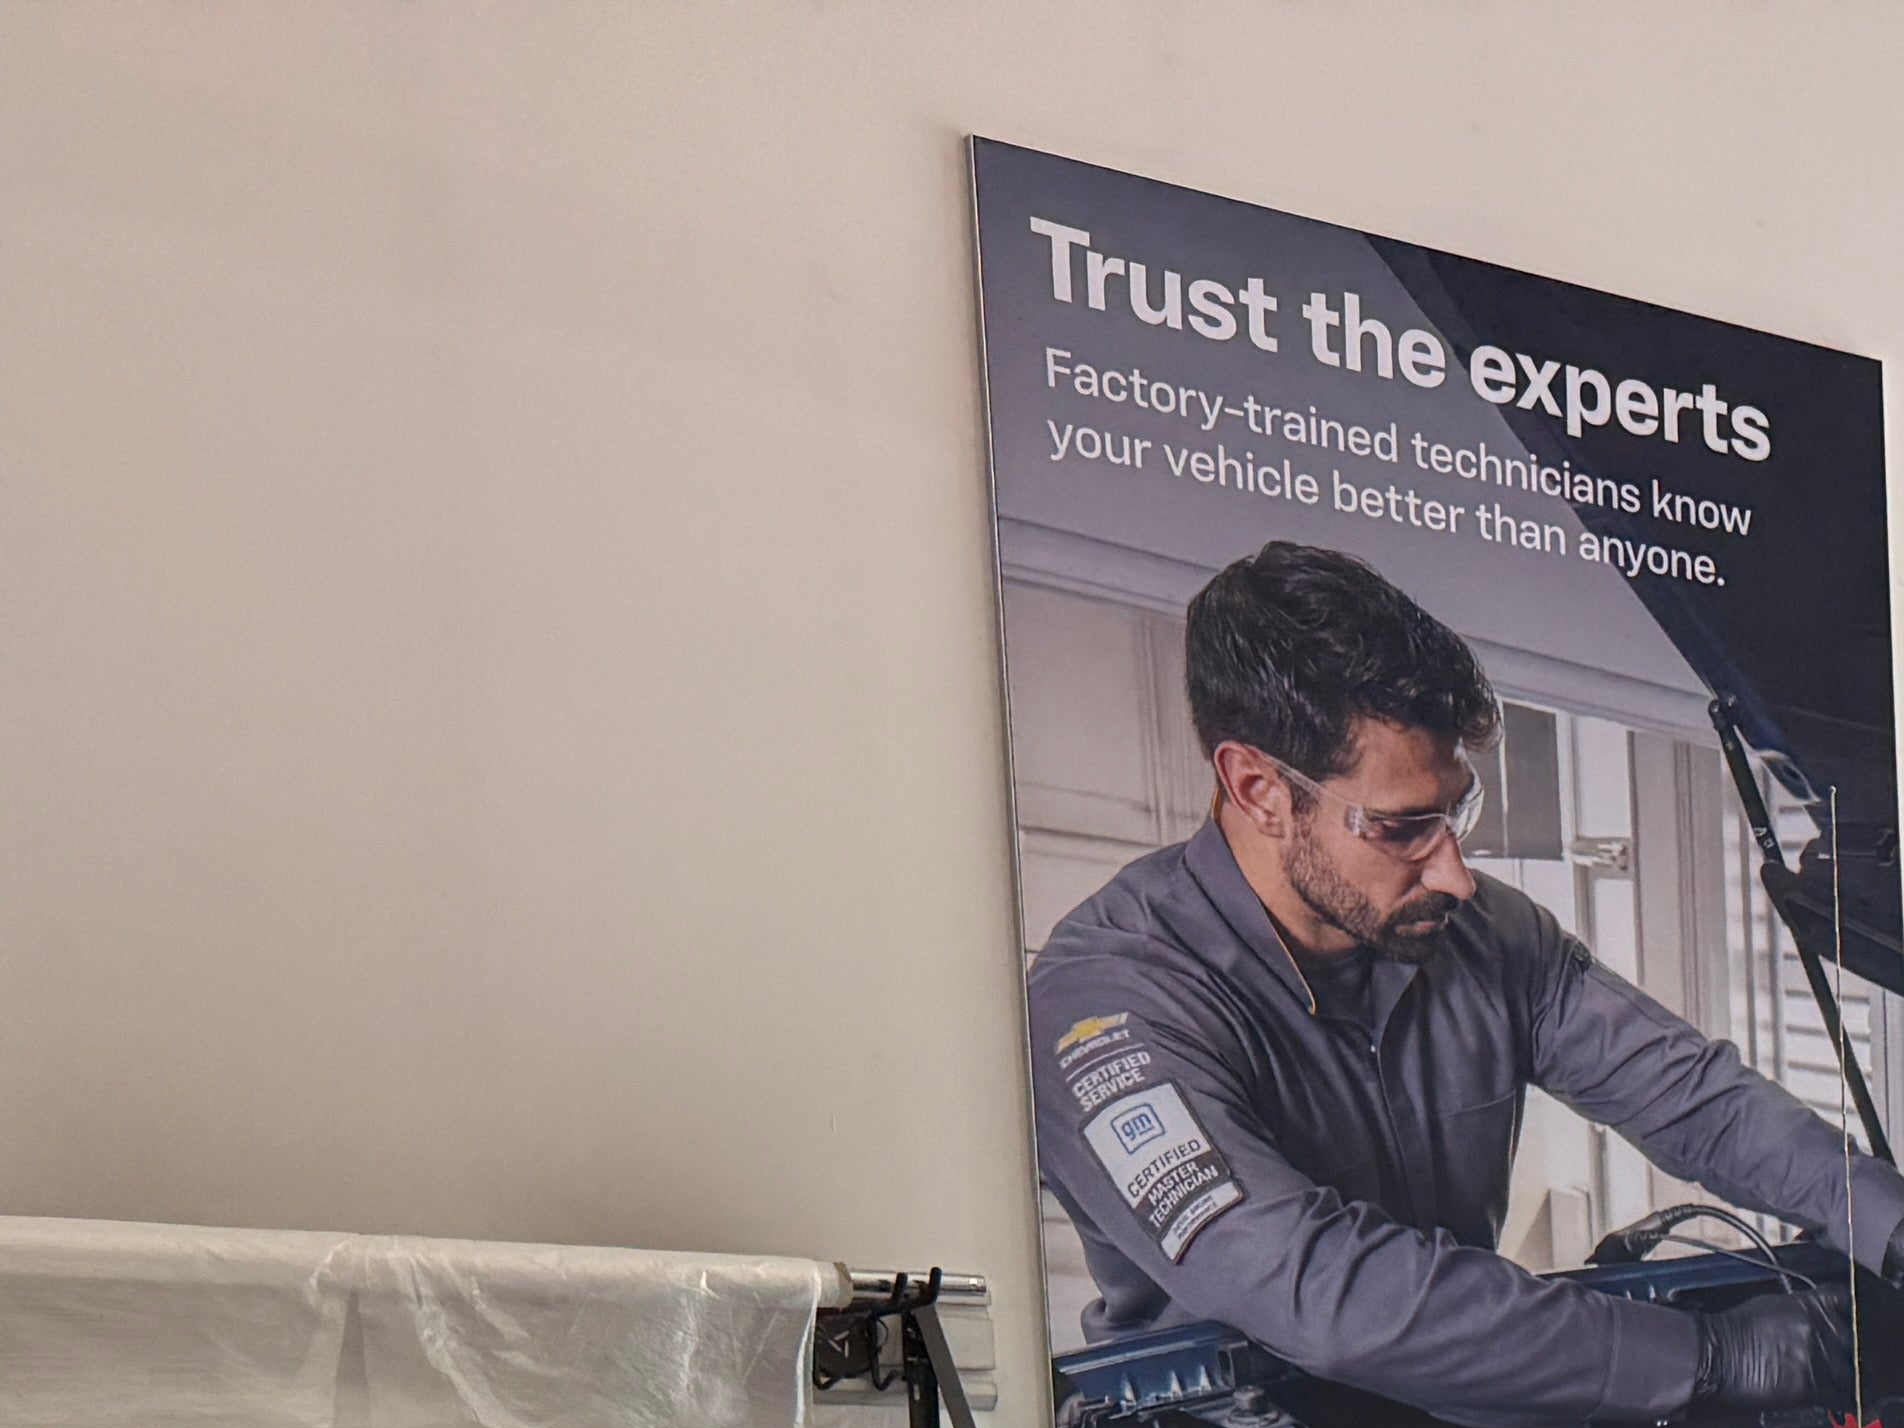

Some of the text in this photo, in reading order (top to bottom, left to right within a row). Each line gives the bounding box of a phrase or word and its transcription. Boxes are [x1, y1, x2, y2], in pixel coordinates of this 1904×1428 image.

[1030, 216, 1771, 462] Trust the experts
[1046, 347, 1752, 535] Factory-trained technicians know
[1047, 419, 1725, 586] your vehicle better than anyone.
[1059, 1028, 1131, 1069] CHEVROLET
[1072, 1050, 1152, 1099] CERTIFIED
[1079, 1067, 1147, 1114] SERVICE
[1127, 1138, 1202, 1199] CERTIFIED
[1147, 1160, 1200, 1207] MASTER
[1149, 1164, 1219, 1228] TECHNICIAN
